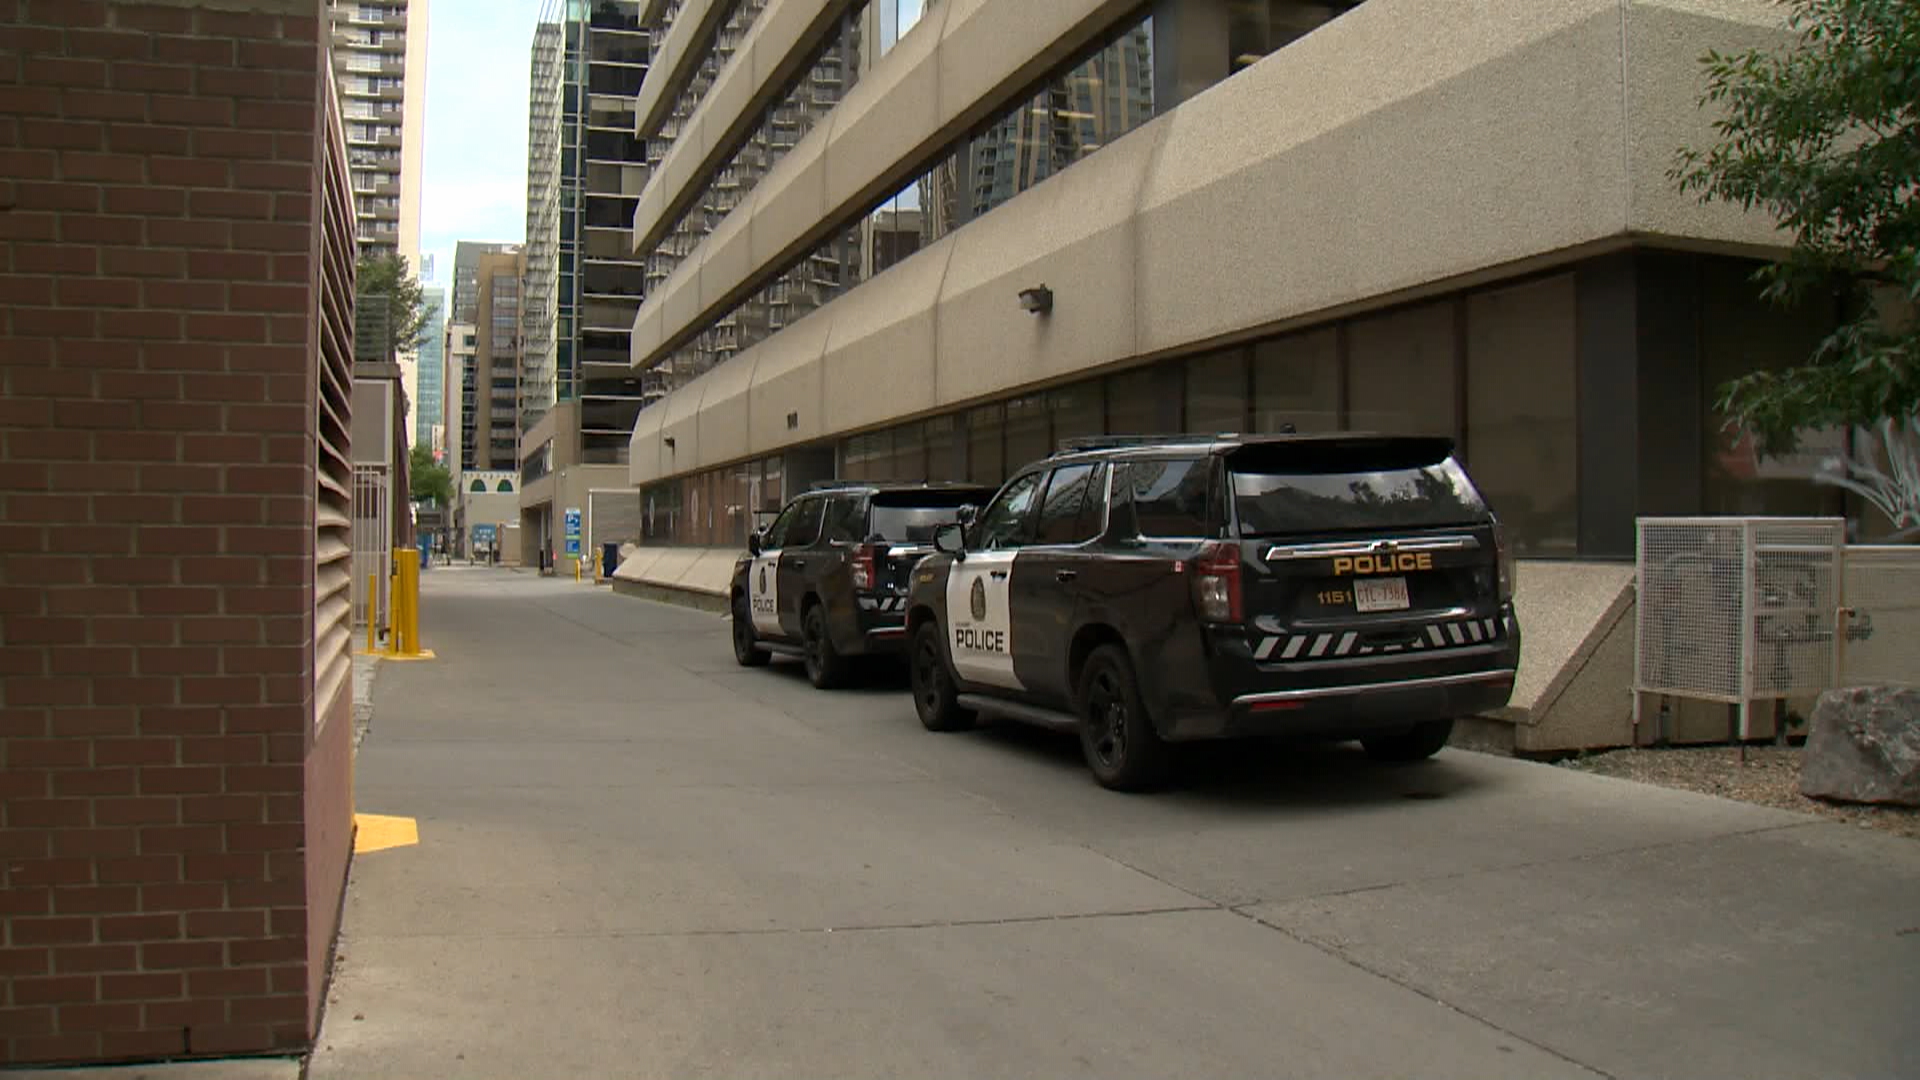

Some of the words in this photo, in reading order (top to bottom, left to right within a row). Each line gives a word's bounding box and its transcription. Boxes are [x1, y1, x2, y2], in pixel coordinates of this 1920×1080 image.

[1334, 553, 1432, 575] POLICE
[753, 599, 774, 612] POLICE
[956, 629, 1004, 652] POLICE
